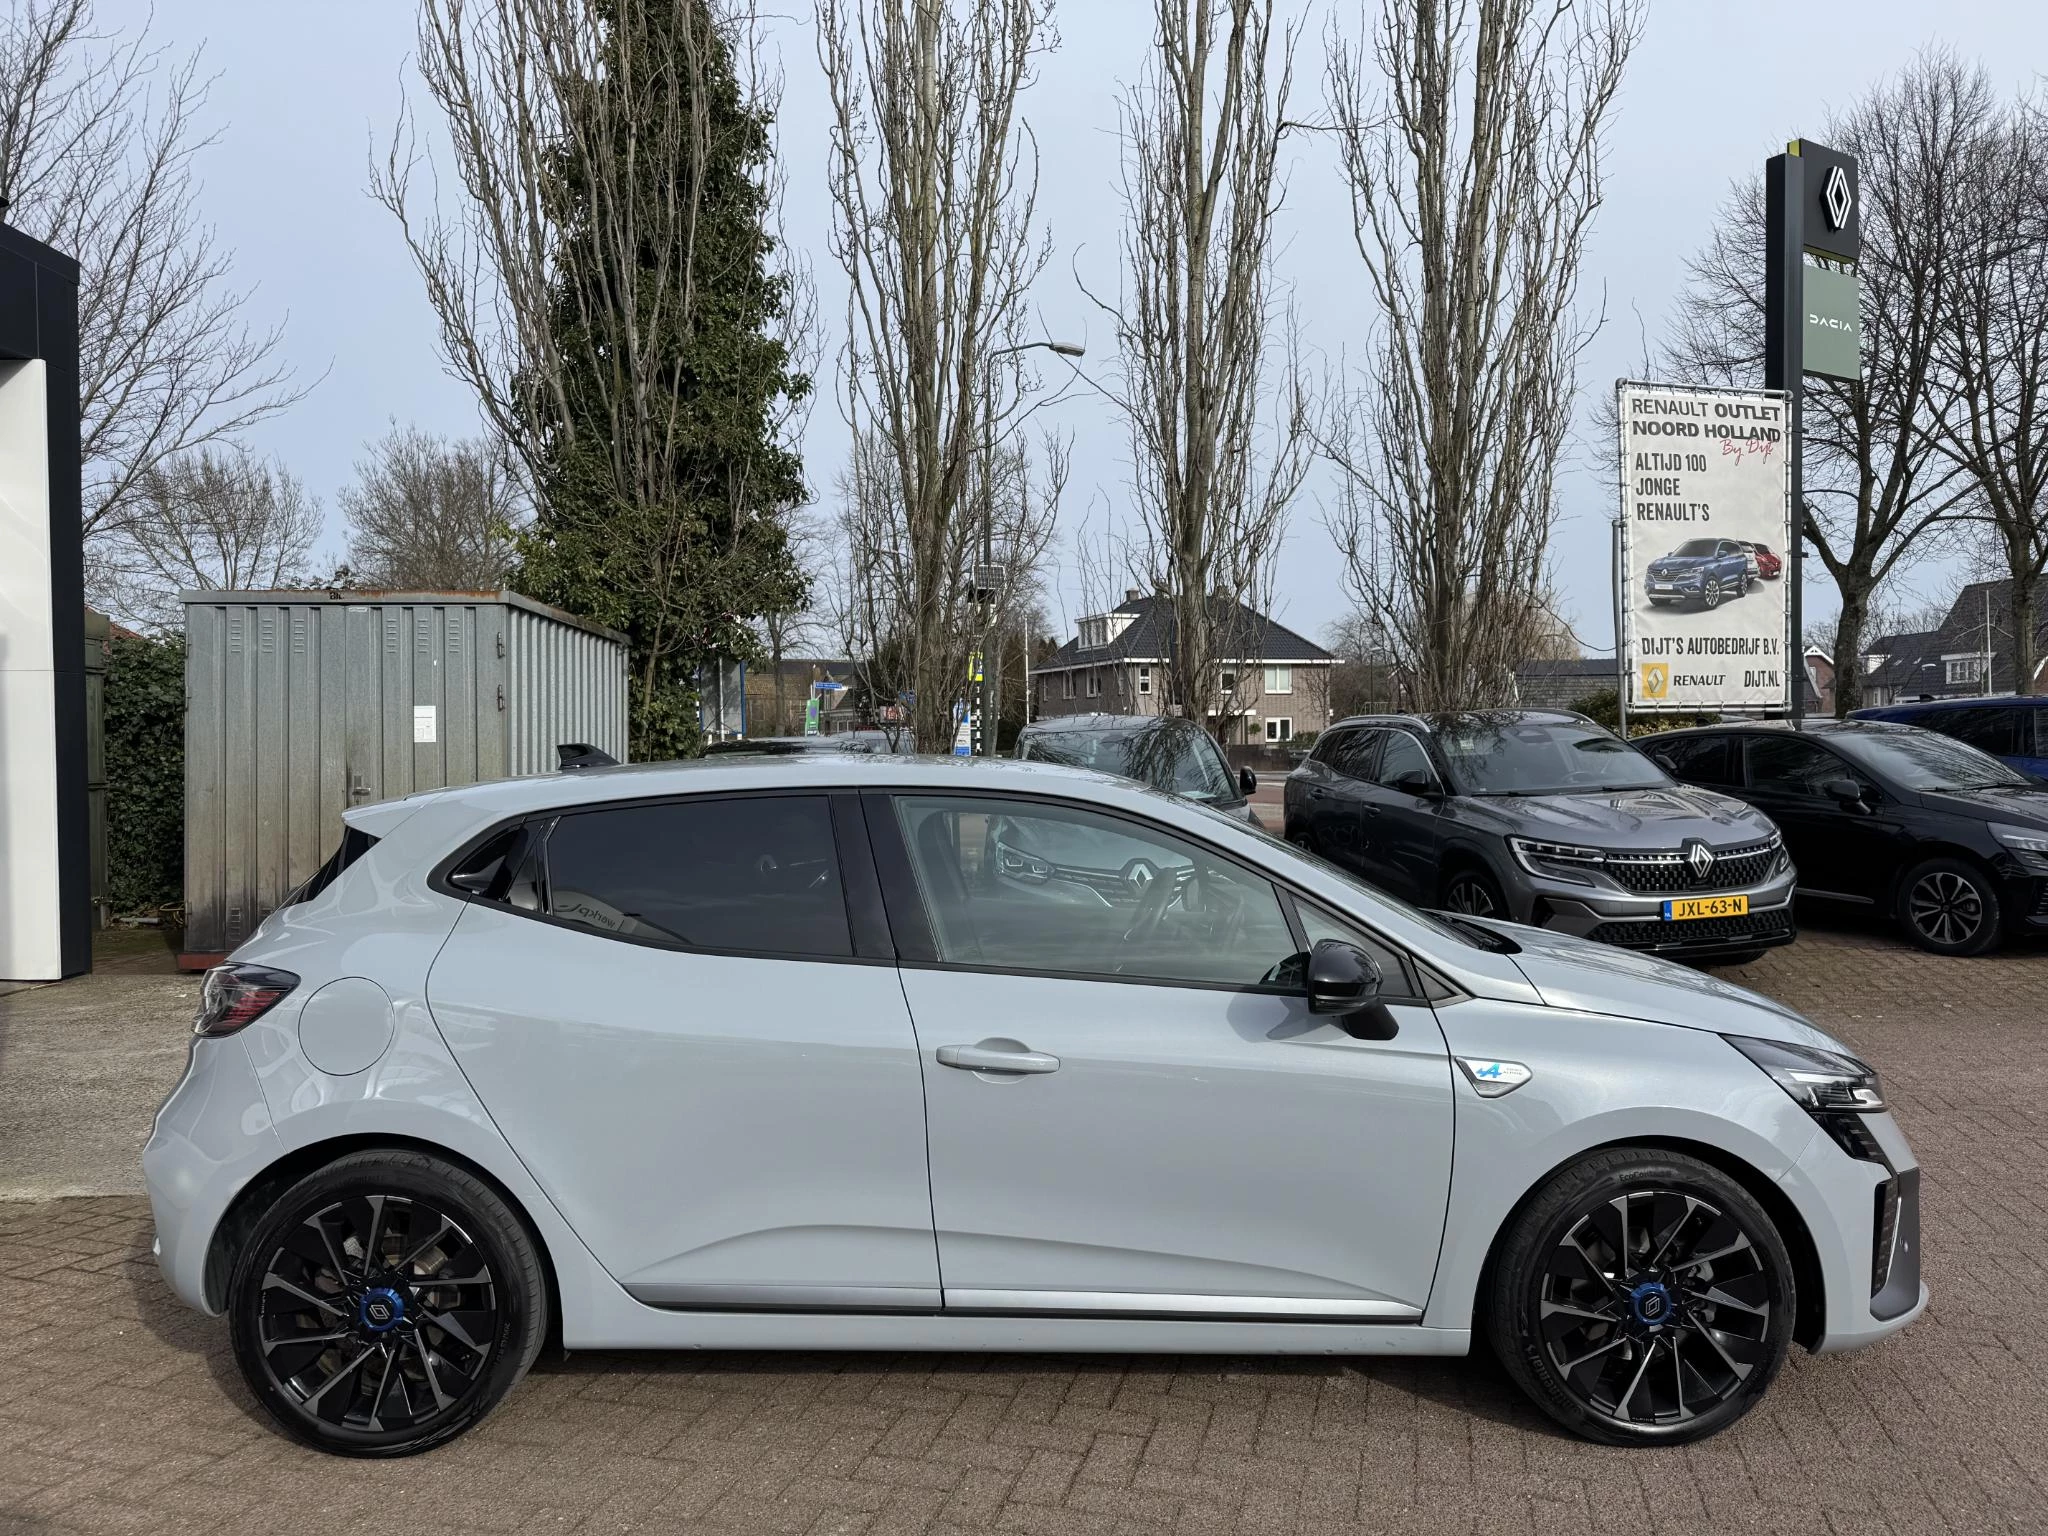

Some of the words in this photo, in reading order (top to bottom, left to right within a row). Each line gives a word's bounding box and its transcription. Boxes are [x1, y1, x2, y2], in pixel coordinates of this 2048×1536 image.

[1809, 313, 1852, 332] DACIA
[1632, 398, 1708, 417] RENAULT
[1714, 403, 1780, 421] OUTLET
[1632, 420, 1700, 437] NOORD
[1704, 424, 1781, 442] HOLLAND
[1720, 438, 1744, 466] By
[1635, 452, 1682, 471] ALTIJD
[1686, 454, 1707, 472] 100
[1636, 477, 1681, 496] JONGE
[1637, 502, 1710, 521] RENAULT'S
[1641, 637, 1684, 655] DIJT'S
[1687, 637, 1760, 655] AUTOBEDRIJF
[1763, 638, 1780, 655] B.V.
[1673, 674, 1726, 686] RENAULT
[1744, 670, 1780, 688] DIJT.NL
[1679, 898, 1742, 917] JXL-63-N
